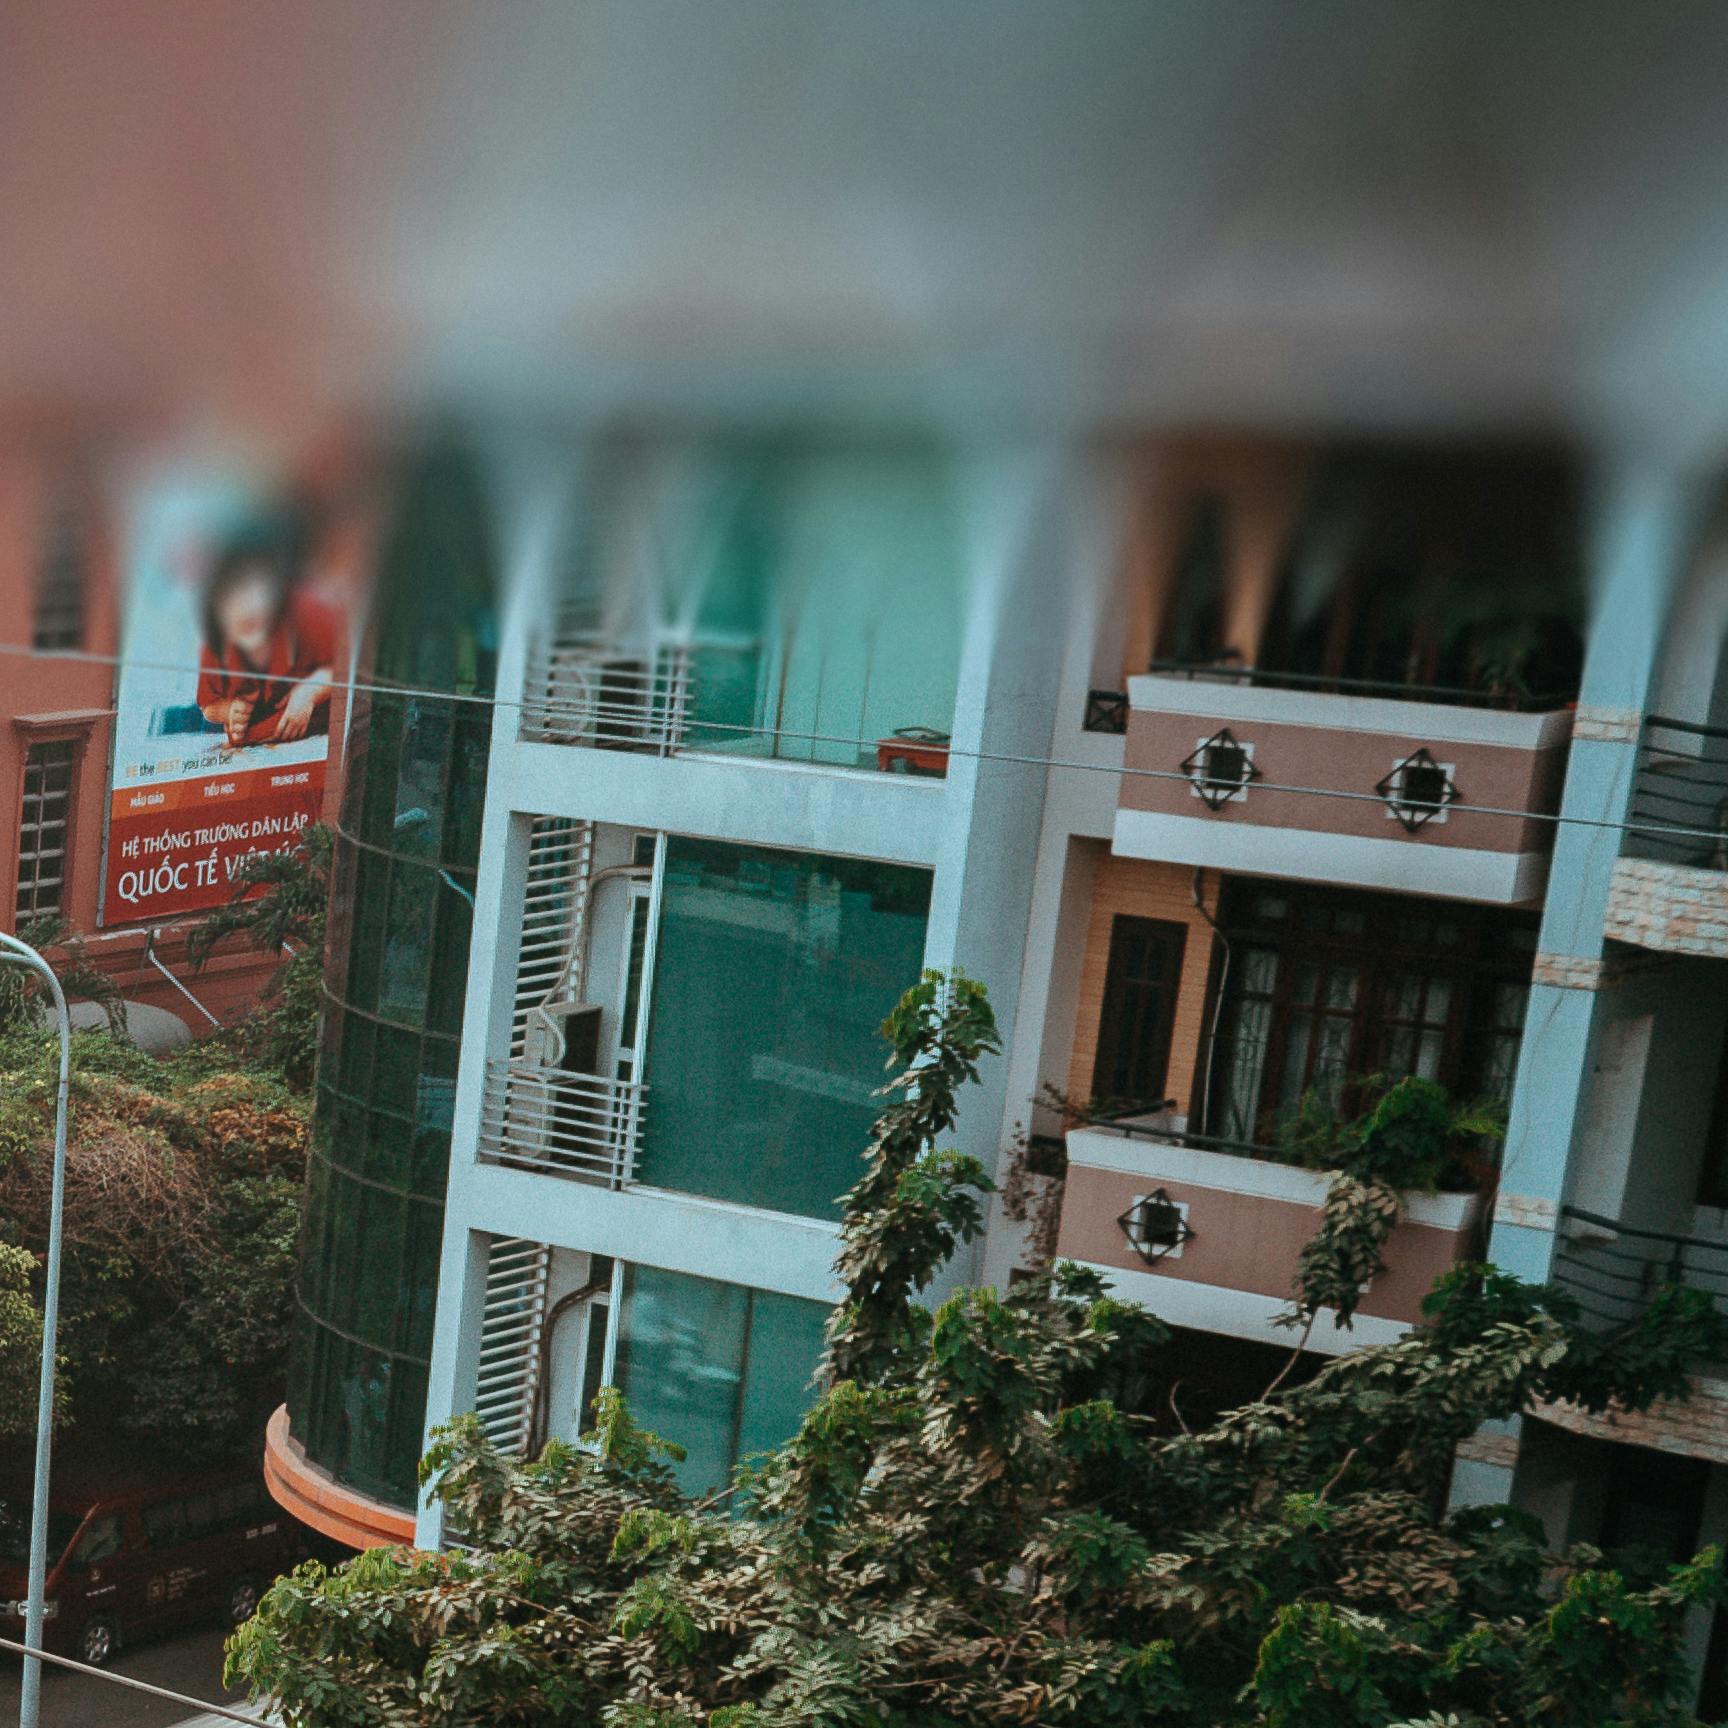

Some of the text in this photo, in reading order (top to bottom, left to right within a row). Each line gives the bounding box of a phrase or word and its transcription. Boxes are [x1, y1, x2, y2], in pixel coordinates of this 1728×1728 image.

[121, 835, 140, 859] HỆ
[143, 828, 191, 854] THỐNG
[252, 816, 281, 838] DÂN
[283, 811, 309, 834] LẬP
[118, 854, 189, 904] QUỐC
[194, 847, 219, 887] TẾ
